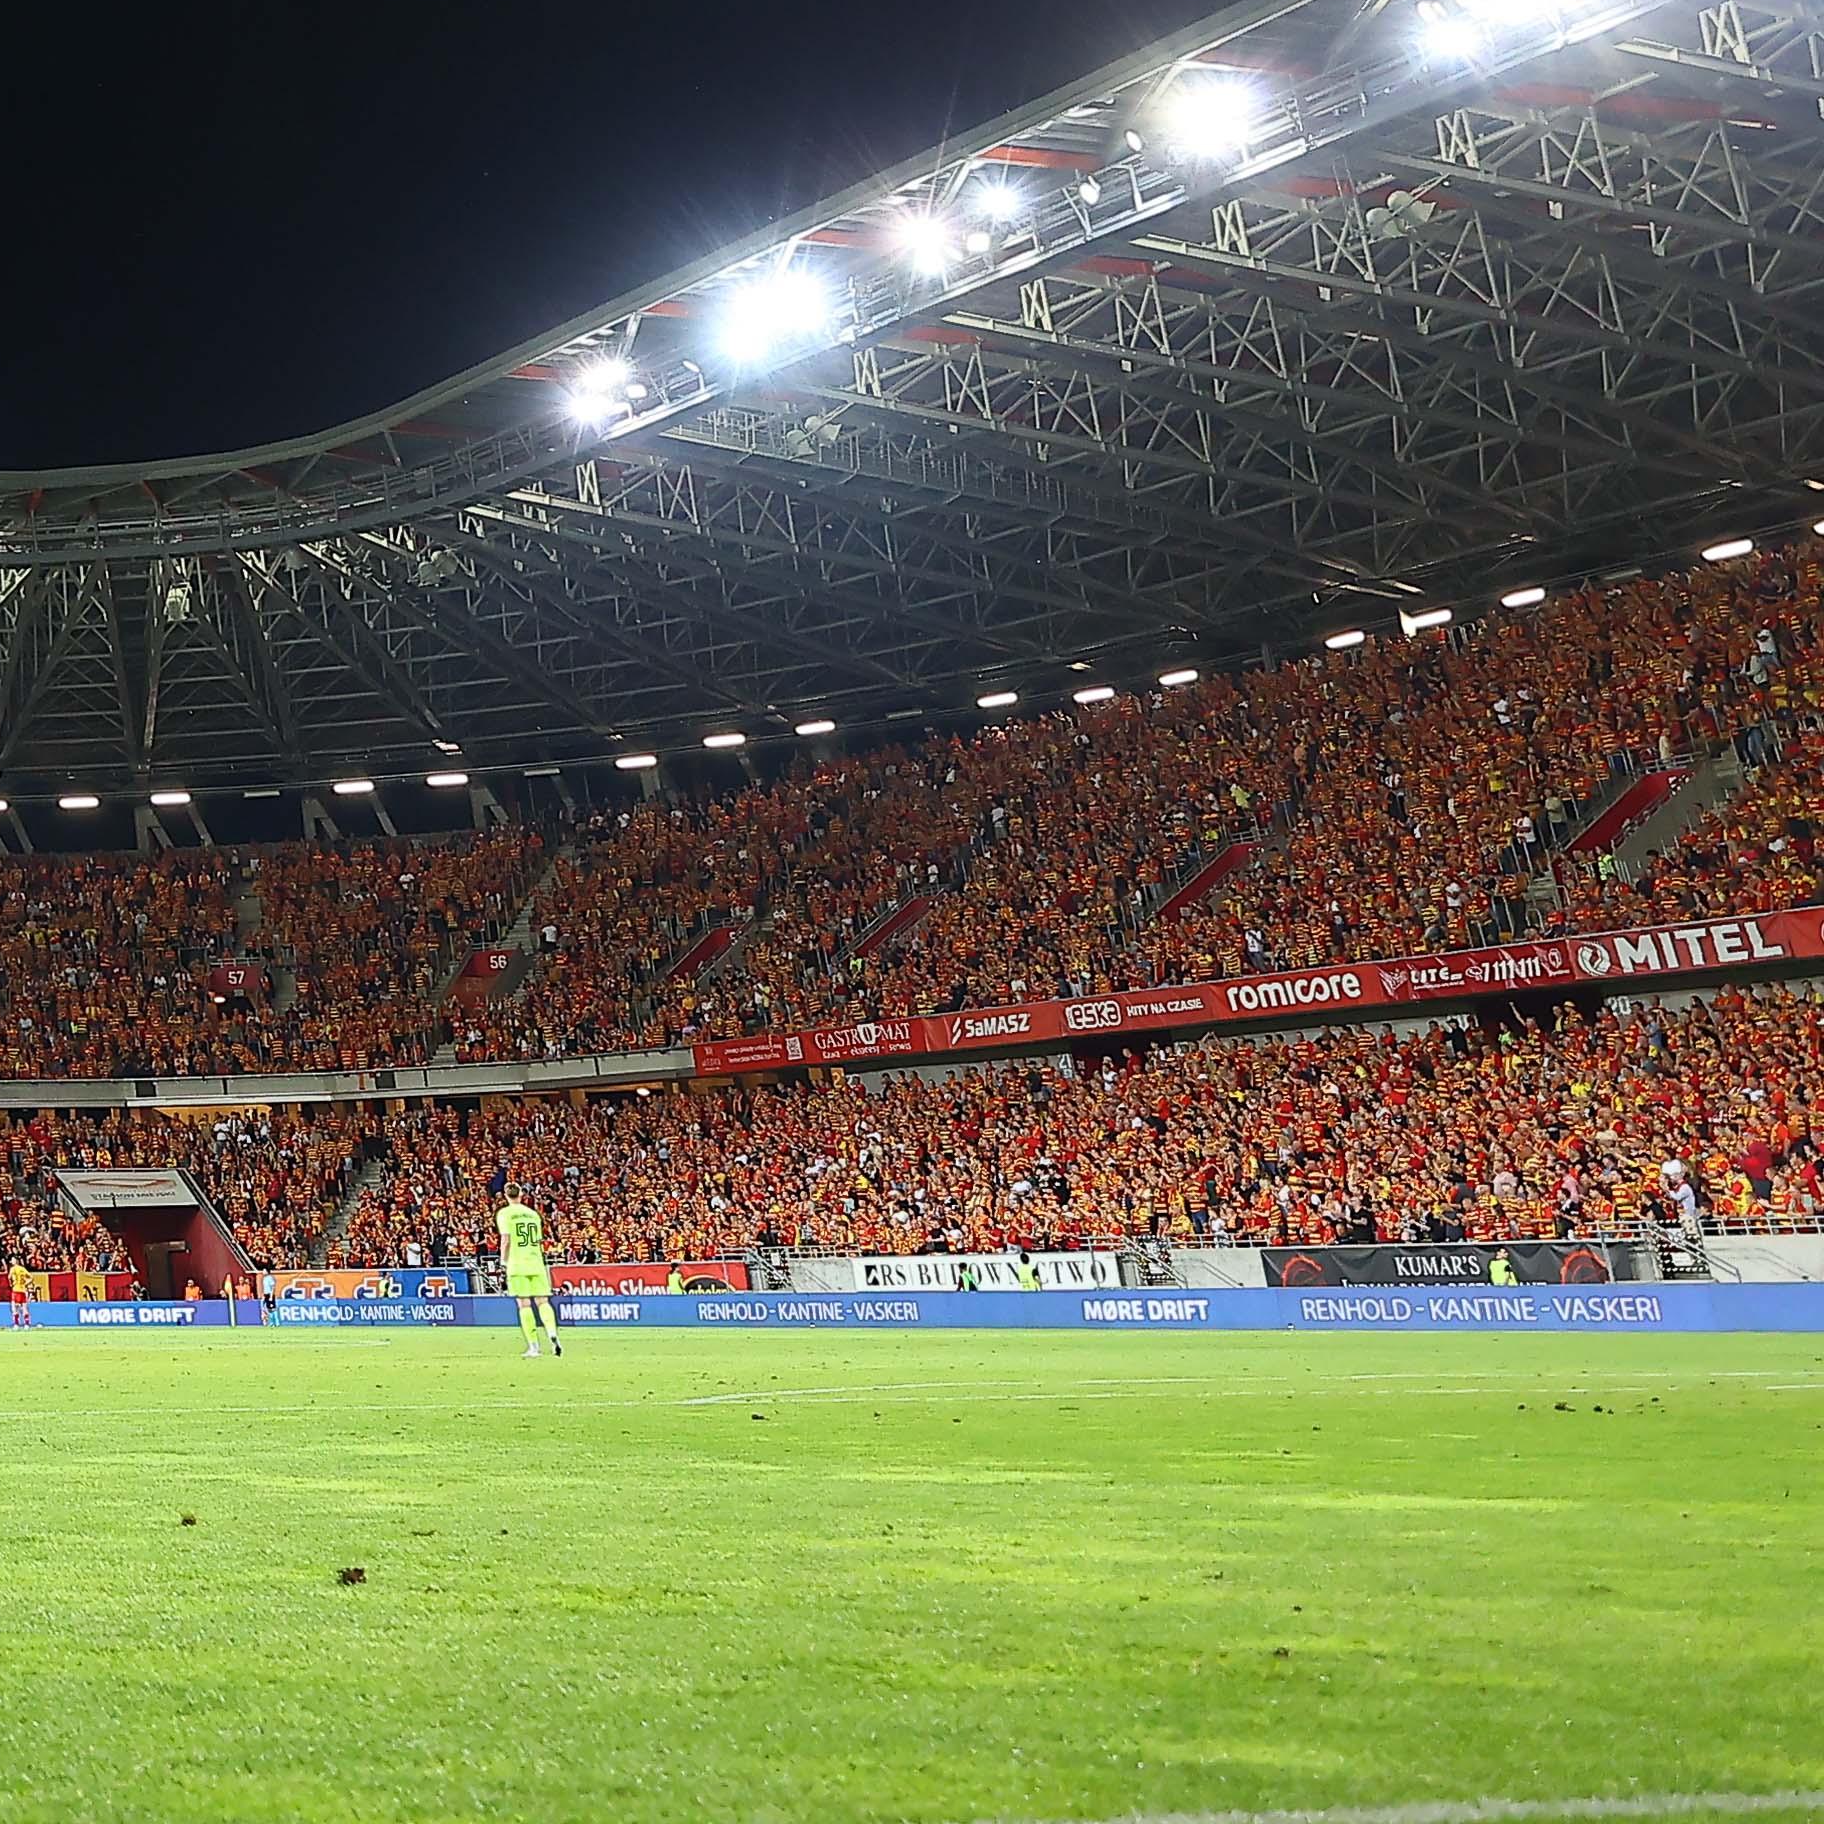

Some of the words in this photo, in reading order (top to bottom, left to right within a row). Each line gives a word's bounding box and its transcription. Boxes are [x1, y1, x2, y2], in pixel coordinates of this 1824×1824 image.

[1614, 915, 1784, 973] MITEL
[490, 954, 508, 970] 56
[228, 970, 245, 985] 57
[1226, 973, 1362, 1012] romicore
[1126, 1003, 1150, 1017] HITY
[1151, 1002, 1165, 1014] NA
[1167, 997, 1205, 1013] CZASIE
[964, 1013, 1031, 1036] SaMASZ
[516, 1222, 538, 1247] 50
[881, 1262, 906, 1287] RS
[1394, 1254, 1481, 1276] KUMAR'S
[79, 1307, 136, 1324] MØRE
[139, 1306, 196, 1323] DRIFT
[280, 1302, 353, 1321] RENHOLD
[361, 1302, 405, 1321] KANTINE
[411, 1301, 454, 1321] VASKERI
[560, 1303, 599, 1321] MØRE
[601, 1303, 640, 1320] DRIFT
[698, 1302, 767, 1321] RENHOLD
[778, 1302, 844, 1321] KANTINE
[853, 1301, 919, 1321] VASKERI
[1083, 1300, 1145, 1321] MØRE
[1148, 1299, 1209, 1321] DRIFT
[1301, 1298, 1410, 1321] RENHOLD
[1429, 1297, 1538, 1321] KANTINE
[1551, 1296, 1662, 1321] VASKERI
